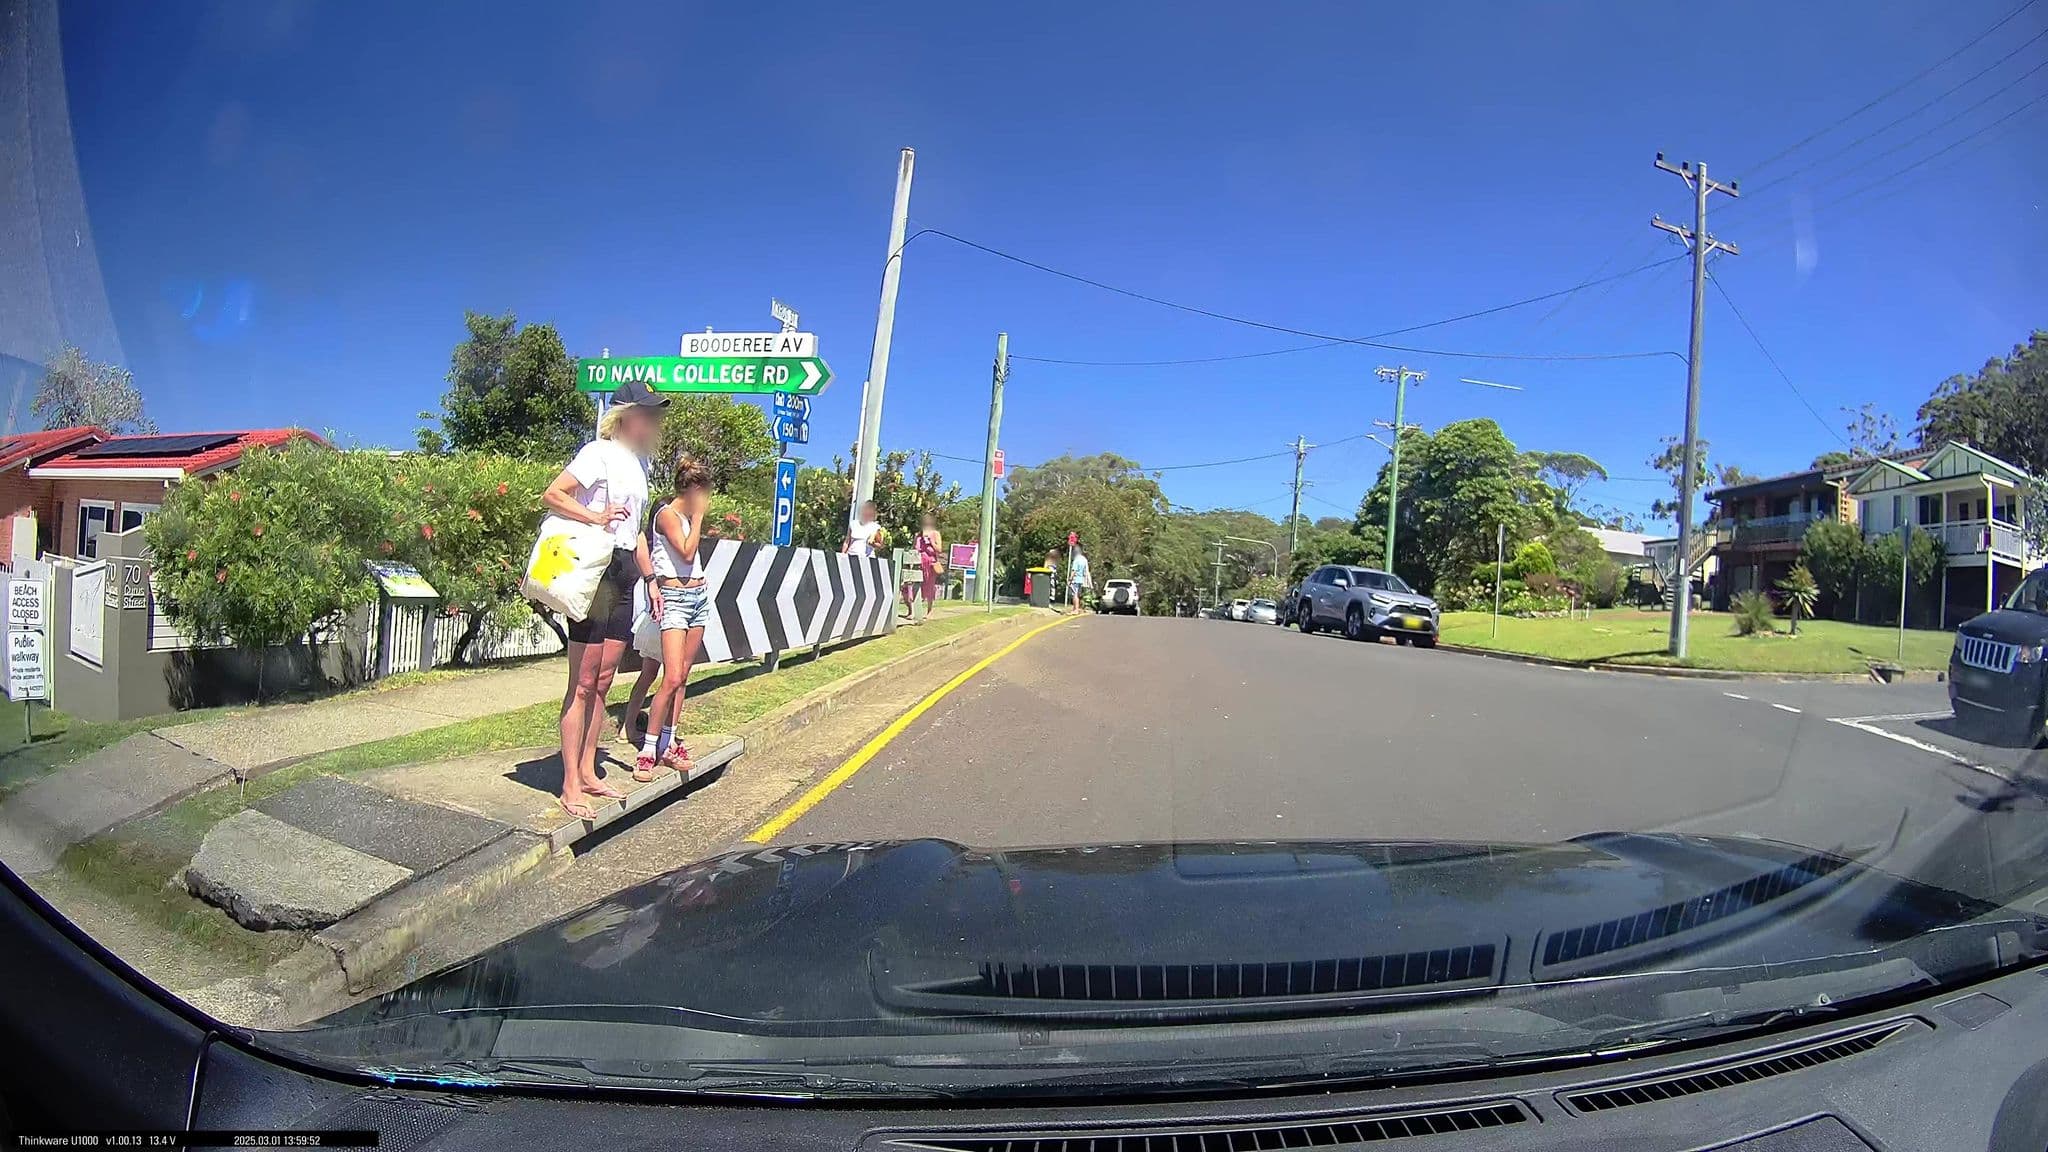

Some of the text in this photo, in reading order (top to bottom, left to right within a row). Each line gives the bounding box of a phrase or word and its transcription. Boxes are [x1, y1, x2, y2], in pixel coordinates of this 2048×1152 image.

[690, 337, 803, 353] BOODEREE AV
[587, 364, 789, 385] TO NAVAL COLLEGE RD
[776, 497, 791, 539] P
[124, 564, 141, 584] 70
[14, 586, 37, 595] BEACH
[12, 598, 39, 608] ACCESS
[12, 609, 39, 619] CLOSED
[14, 636, 35, 648] Public
